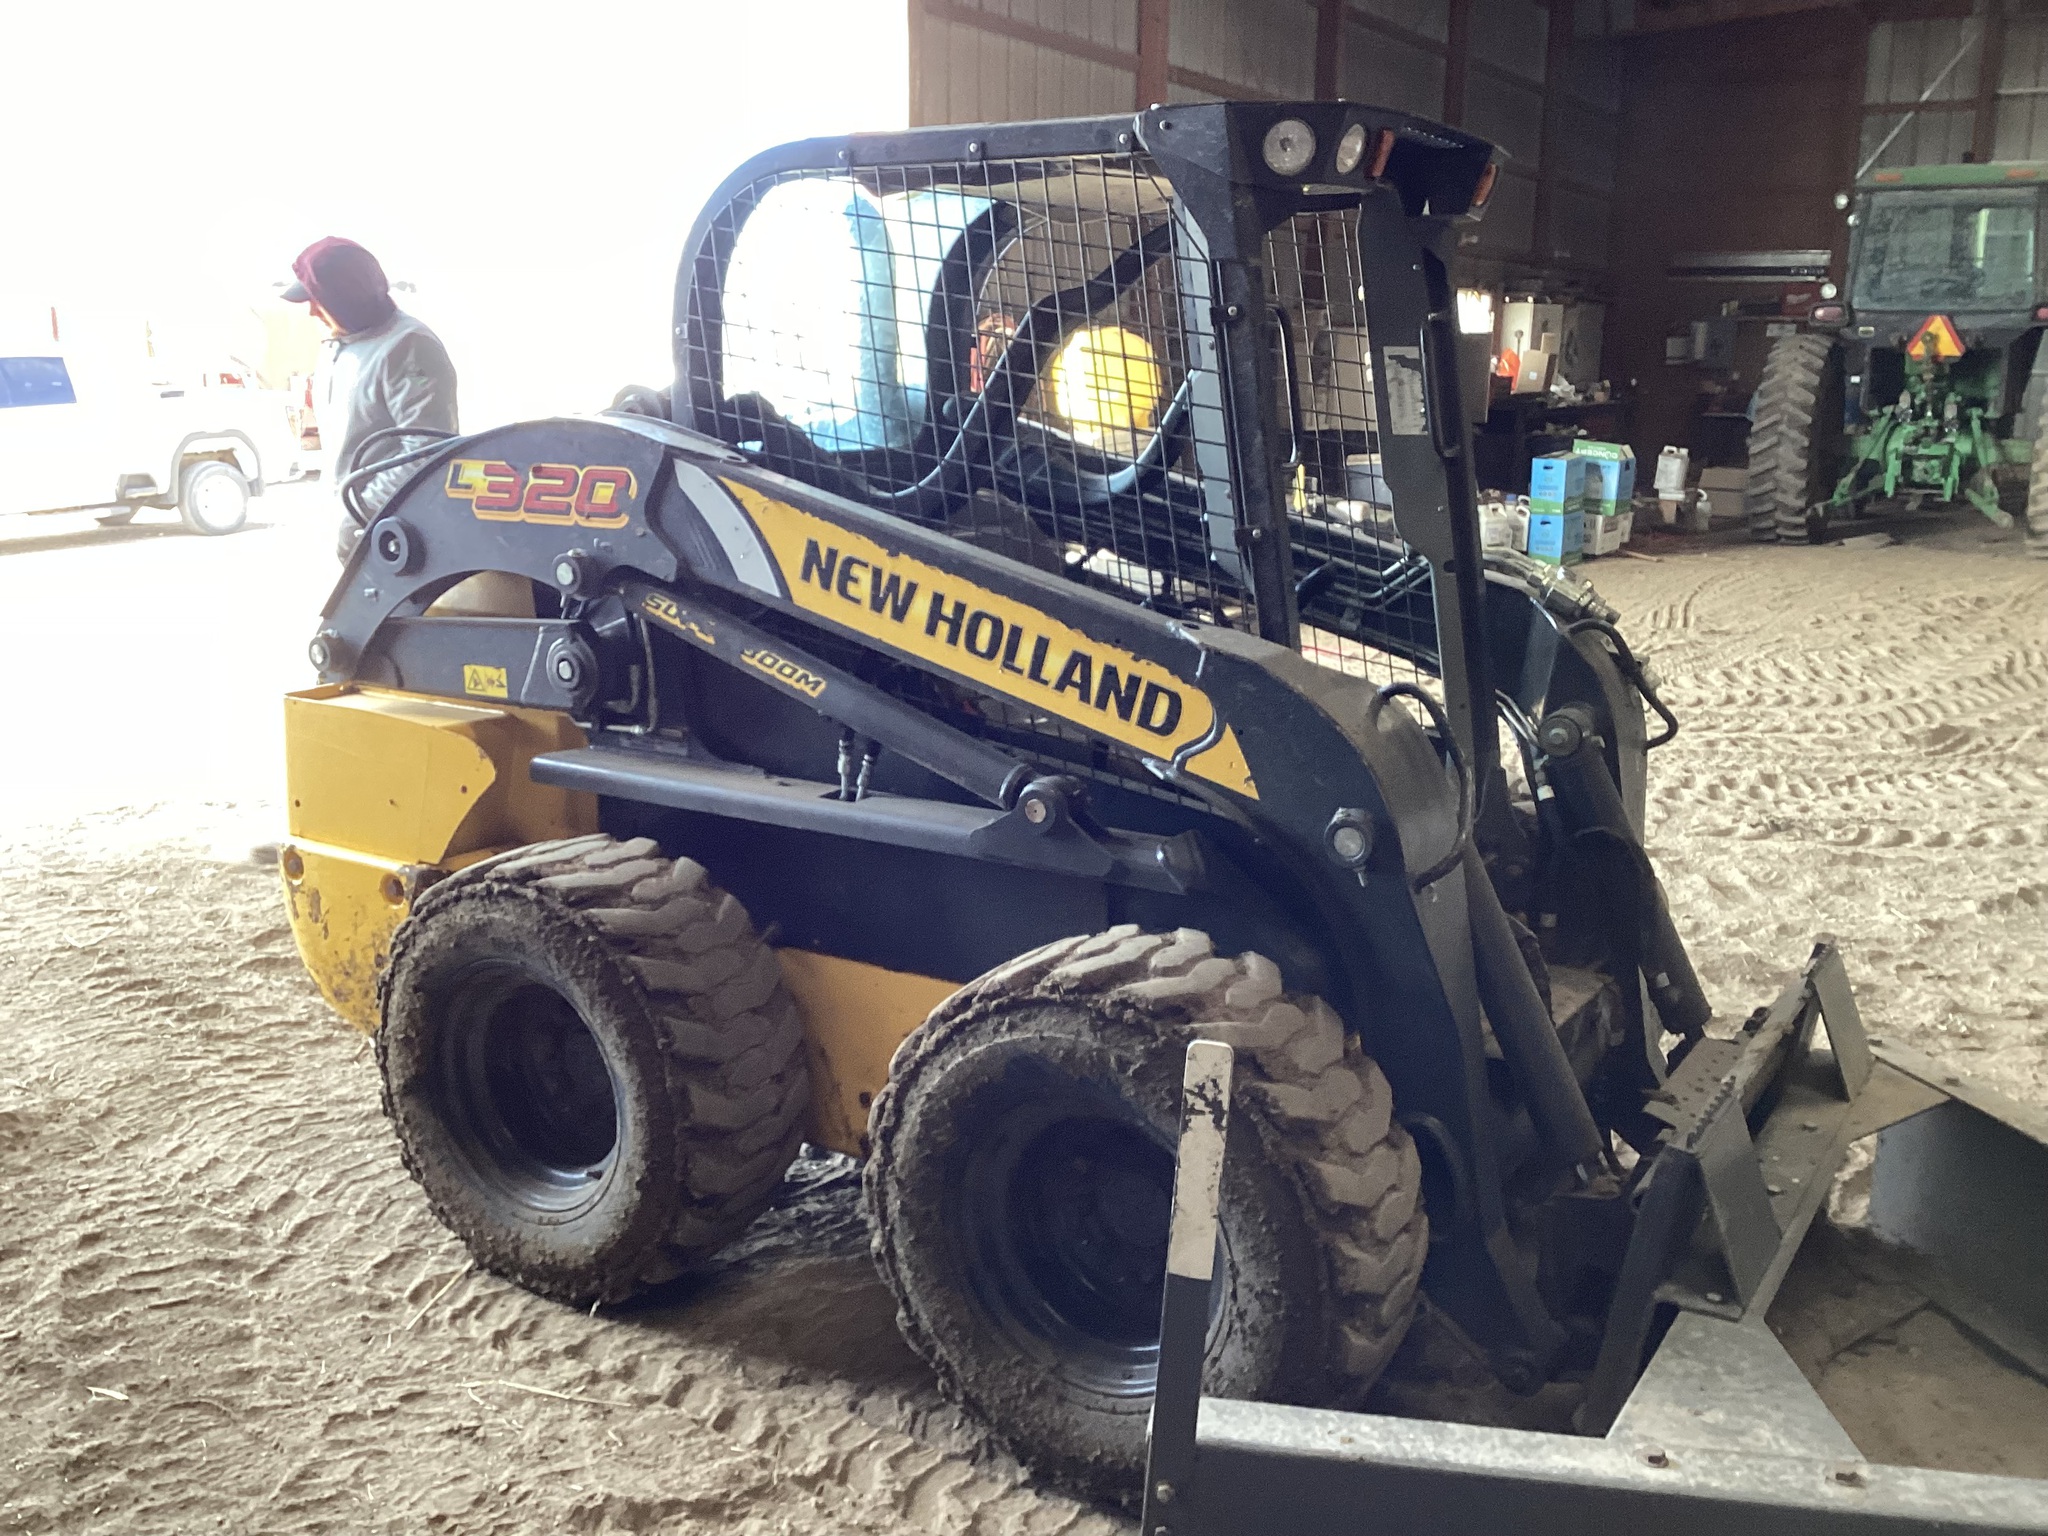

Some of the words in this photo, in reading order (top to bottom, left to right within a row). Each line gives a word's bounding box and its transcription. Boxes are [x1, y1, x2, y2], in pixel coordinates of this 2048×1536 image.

[445, 459, 637, 529] L320
[800, 537, 919, 624] NEW
[924, 591, 1183, 738] HOLLAND
